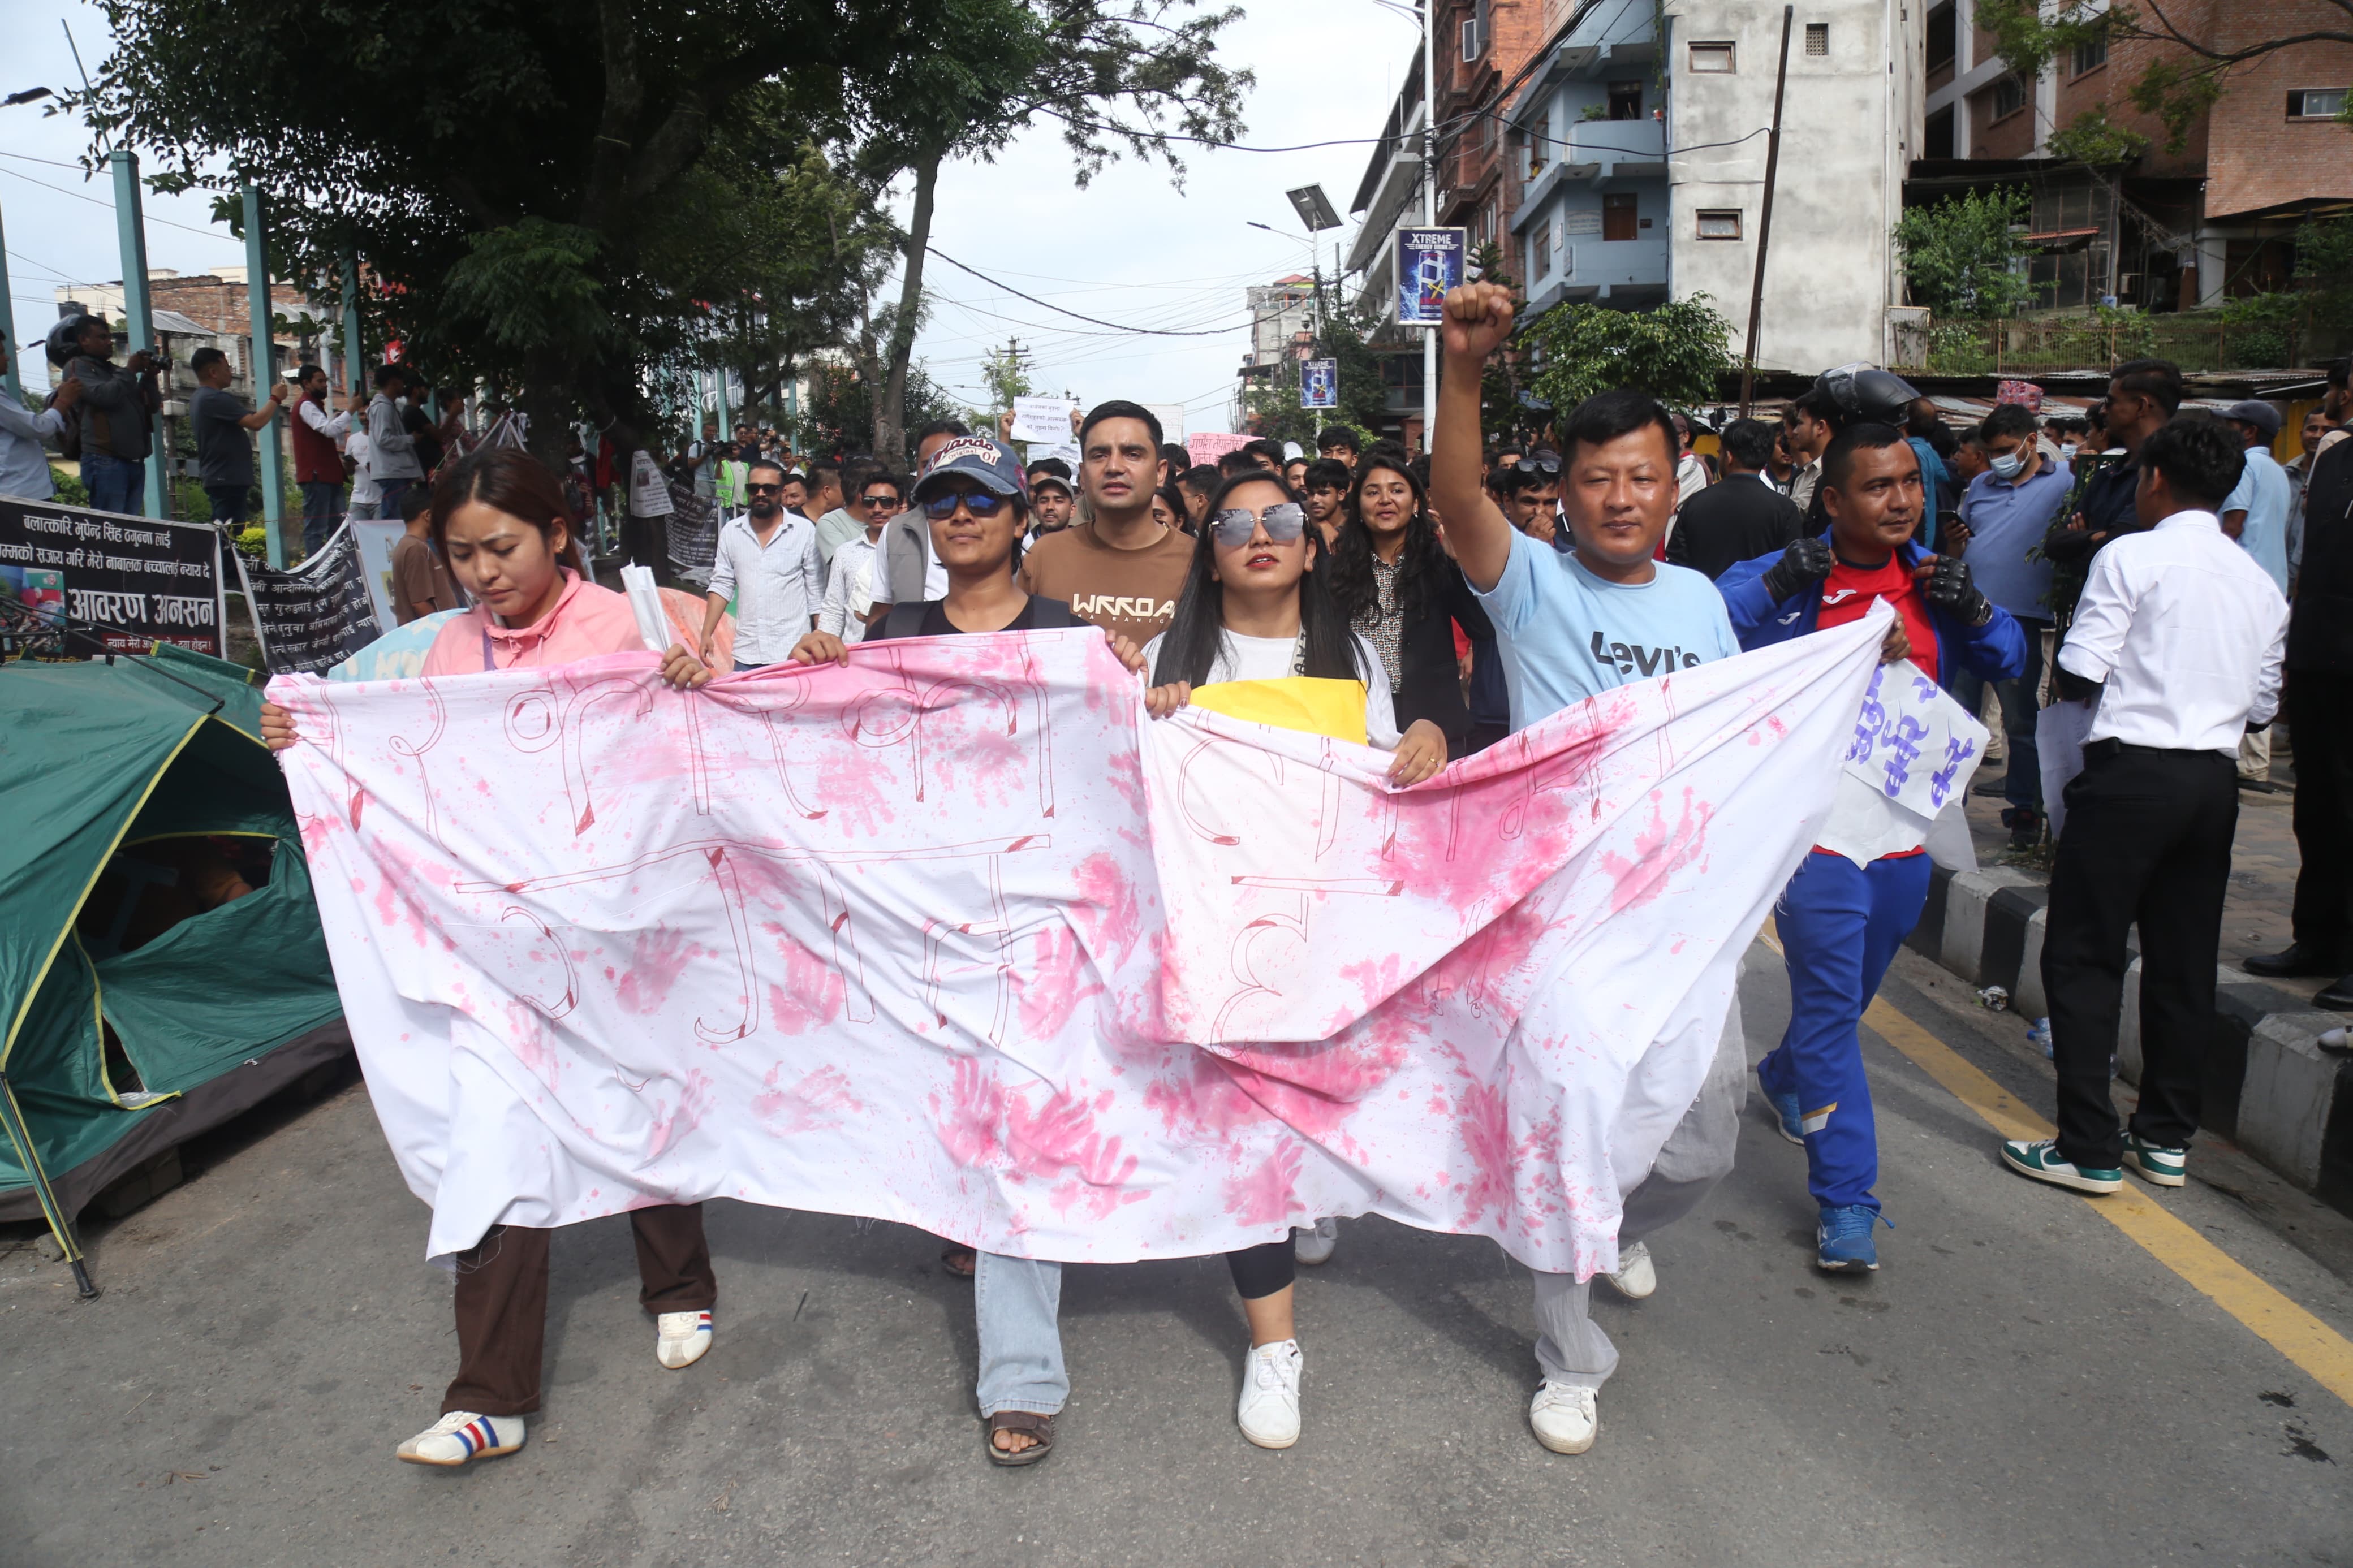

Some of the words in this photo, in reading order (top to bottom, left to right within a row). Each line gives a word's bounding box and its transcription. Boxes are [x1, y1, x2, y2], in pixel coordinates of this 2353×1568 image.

[1412, 233, 1451, 244] XTREME
[103, 521, 122, 543] सिंह
[155, 530, 171, 549] लाई
[0, 542, 33, 561] म्मको
[36, 547, 64, 565] सजाय
[66, 547, 85, 568] गरि
[87, 550, 104, 570] मेरो
[180, 563, 201, 577] न्याय
[202, 561, 210, 578] दे
[68, 588, 147, 625] आवरण
[152, 594, 215, 628] अनसन
[107, 638, 126, 650] न्याय
[128, 636, 140, 649] मेरो
